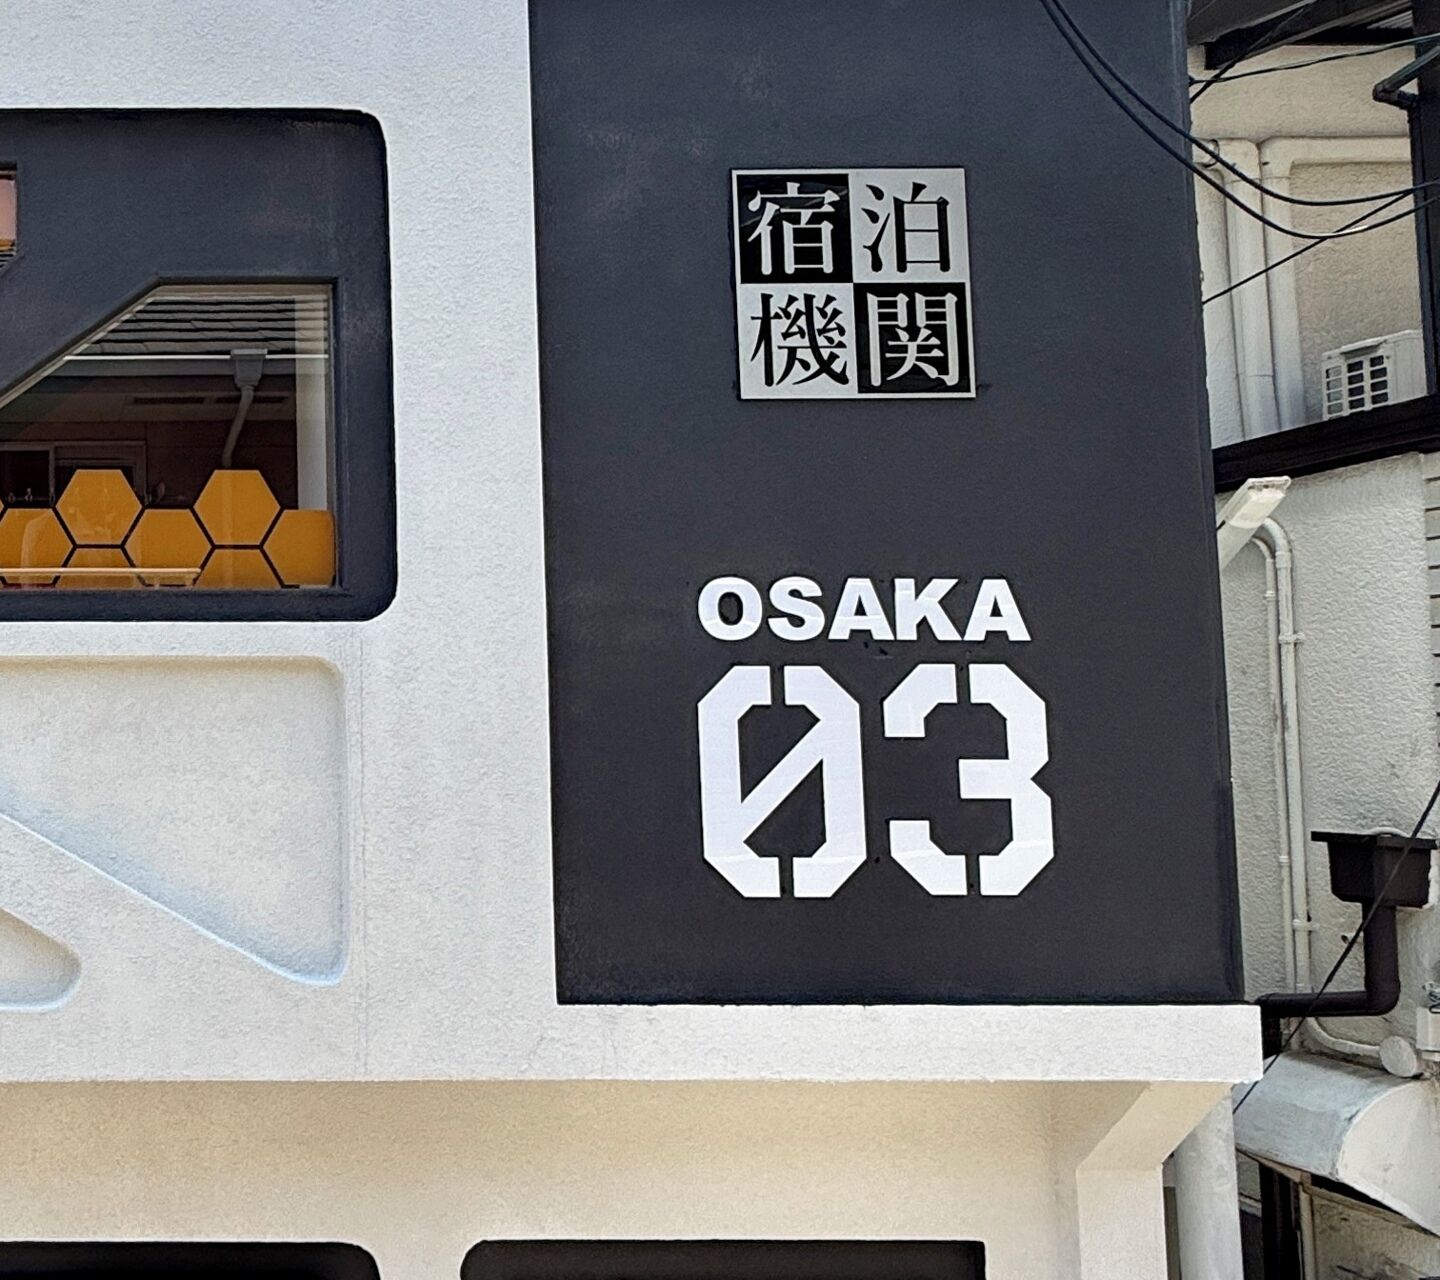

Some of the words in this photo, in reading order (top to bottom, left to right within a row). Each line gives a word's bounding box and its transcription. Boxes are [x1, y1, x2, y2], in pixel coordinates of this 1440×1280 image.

[746, 181, 952, 276] 宿泊
[748, 290, 962, 389] 機関
[697, 575, 1033, 643] OSAKA
[696, 662, 1056, 899] 03
